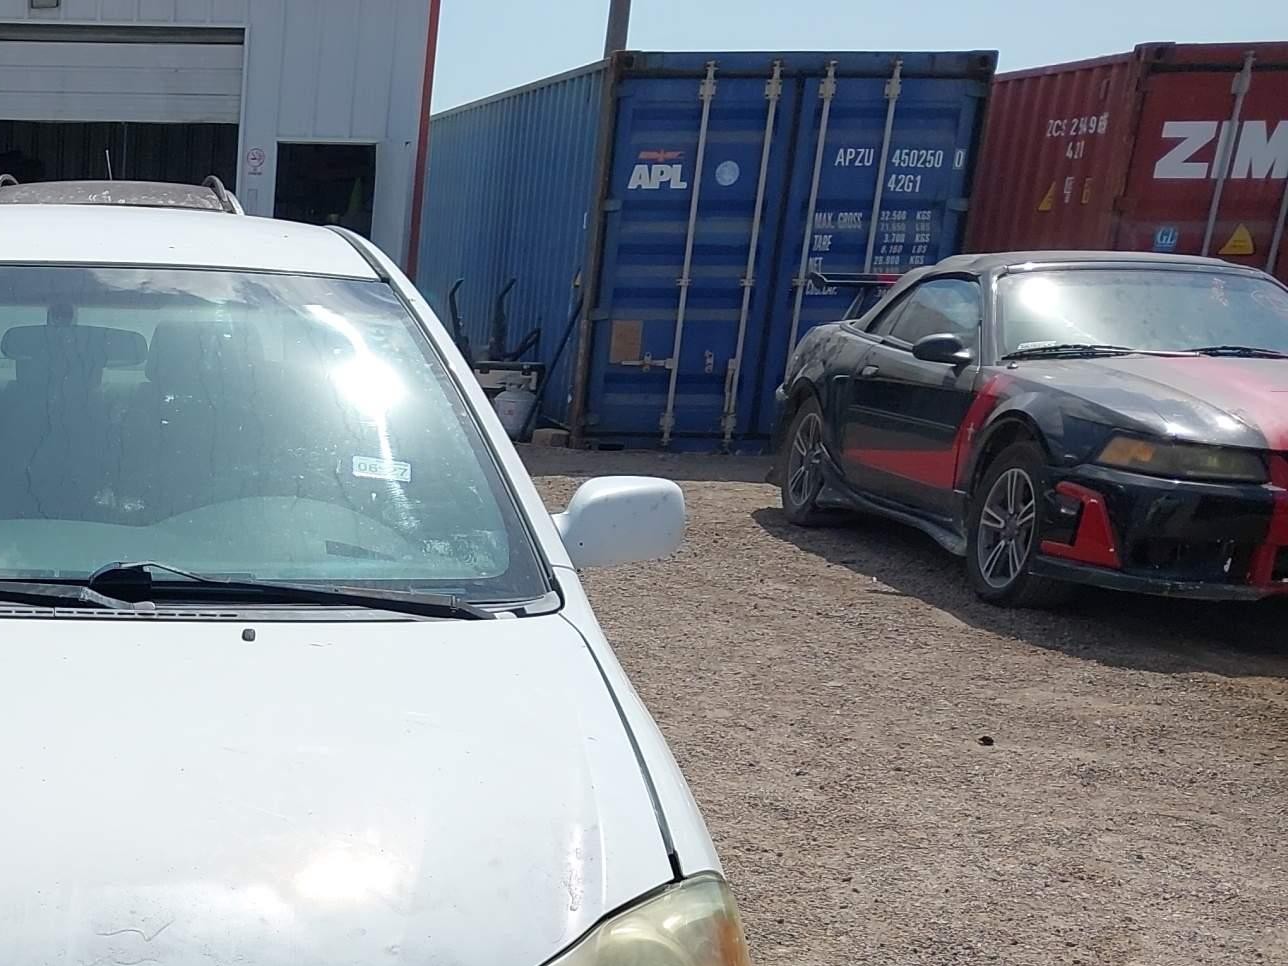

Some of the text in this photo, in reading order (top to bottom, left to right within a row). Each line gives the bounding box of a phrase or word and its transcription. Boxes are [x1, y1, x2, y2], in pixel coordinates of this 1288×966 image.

[834, 148, 874, 166] APZU
[892, 149, 944, 168] 450250
[1153, 120, 1288, 179] ZIM
[627, 164, 688, 189] APL
[887, 174, 921, 192] 42G1
